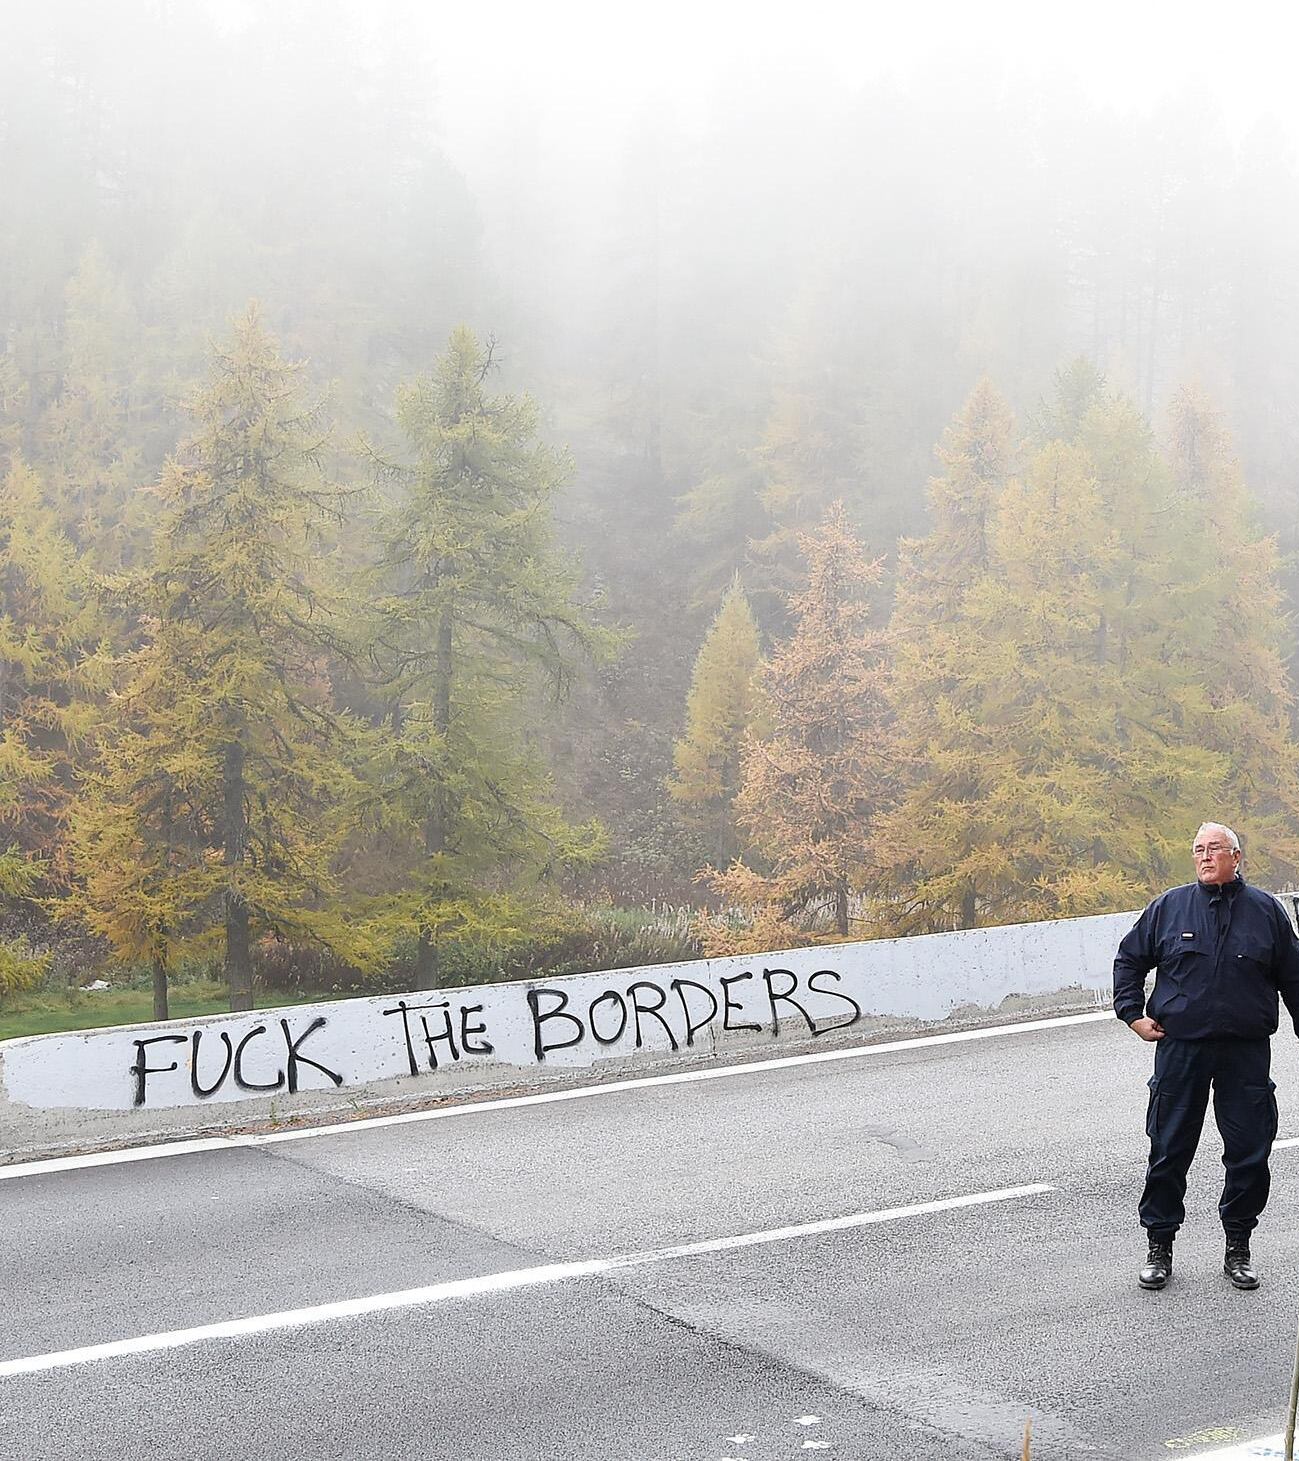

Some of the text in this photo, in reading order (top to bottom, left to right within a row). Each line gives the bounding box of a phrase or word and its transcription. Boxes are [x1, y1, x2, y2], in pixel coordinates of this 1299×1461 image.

[130, 968, 862, 1107] FUCK THE BORDERS
